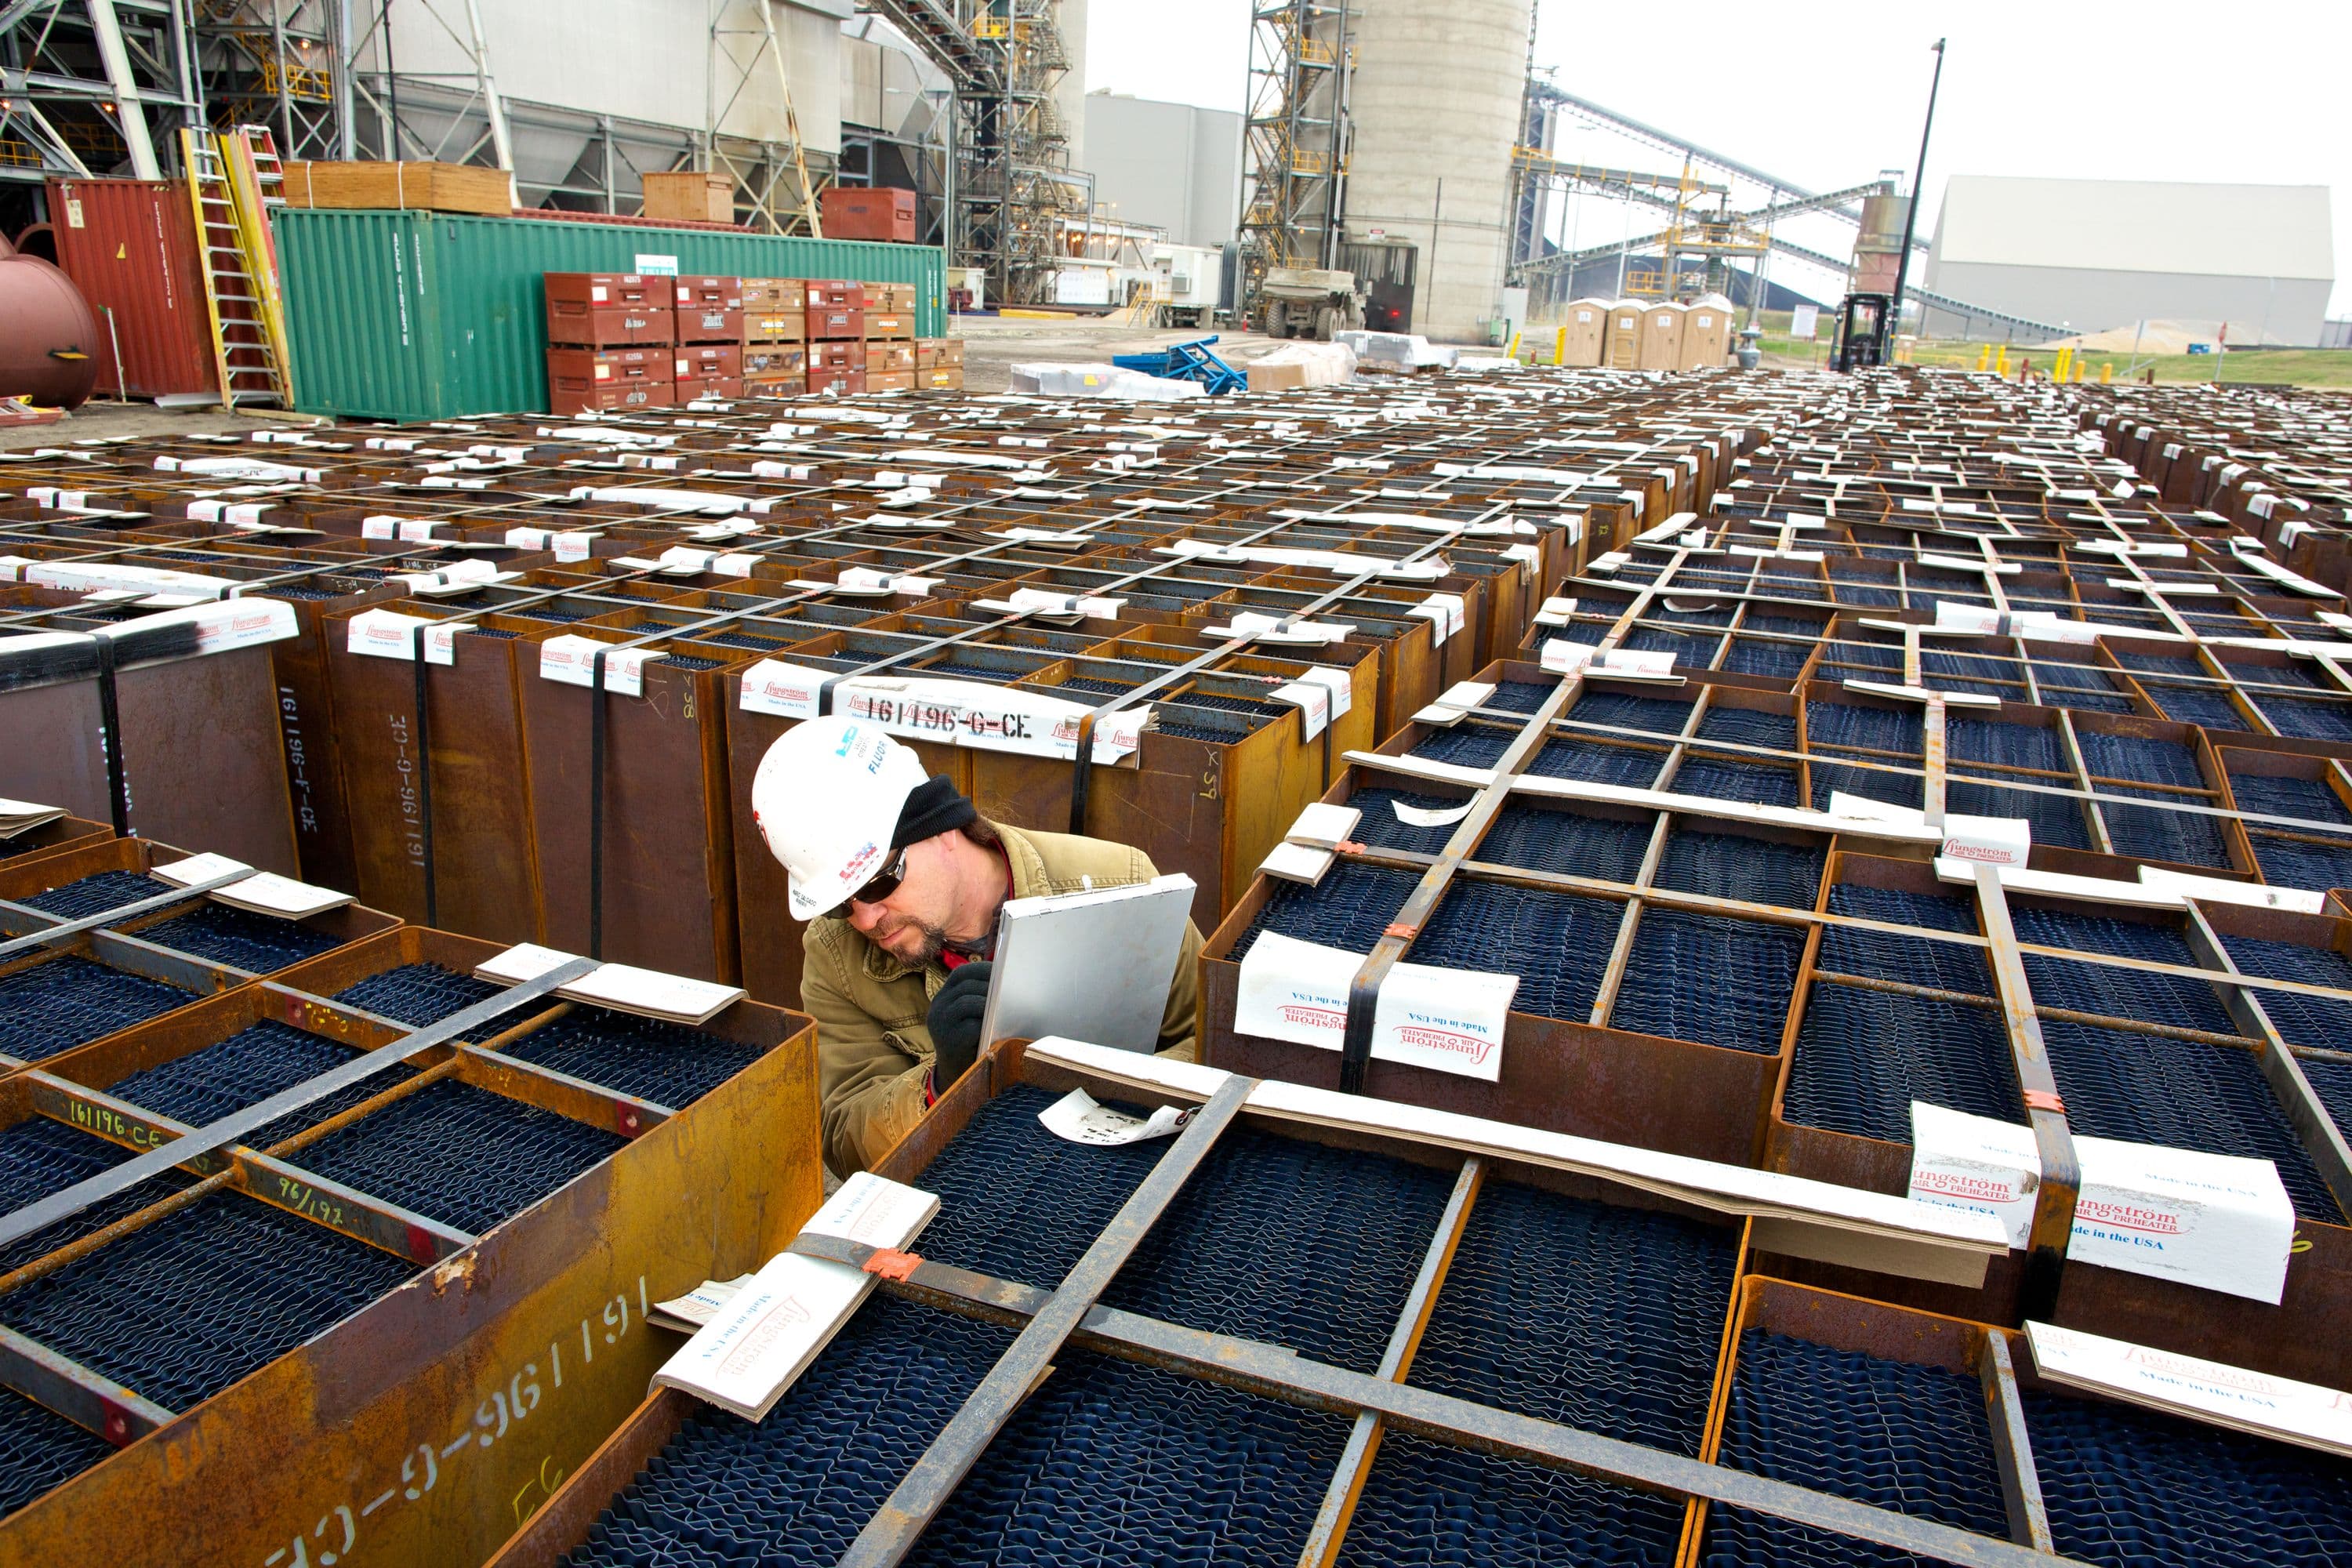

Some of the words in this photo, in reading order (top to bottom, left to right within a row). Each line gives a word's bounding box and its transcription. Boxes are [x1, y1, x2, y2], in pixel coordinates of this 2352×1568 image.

[764, 681, 809, 697] Ljungström
[868, 697, 1032, 739] 161196-G-CE
[868, 741, 887, 775] FLUOR
[1942, 838, 2013, 858] Ljungström
[1291, 992, 1312, 1003] USA
[1315, 994, 1330, 1004] the
[1284, 1007, 1328, 1019] PREHEATER
[1408, 1012, 1430, 1023] USA
[1433, 1016, 1447, 1026] the
[1461, 1022, 1488, 1033] Made
[1400, 1028, 1445, 1041] PREHEATER
[1400, 1034, 1496, 1065] Ljungström
[1463, 1038, 1475, 1047] AIR
[71, 1100, 125, 1135] 161196
[132, 1127, 162, 1149] CE
[1951, 1185, 2010, 1200] PREHEATER
[2225, 1185, 2259, 1198] USA
[2076, 1200, 2179, 1225] ungström
[2114, 1214, 2178, 1232] PREHEATER
[2093, 1229, 2107, 1239] in
[2110, 1232, 2131, 1244] the
[2134, 1236, 2165, 1251] USA
[695, 1294, 722, 1307] Made
[746, 1293, 771, 1314] Made
[2140, 1370, 2183, 1387] Made
[2188, 1381, 2204, 1392] in
[2209, 1385, 2234, 1399] the
[2238, 1393, 2277, 1409] USA
